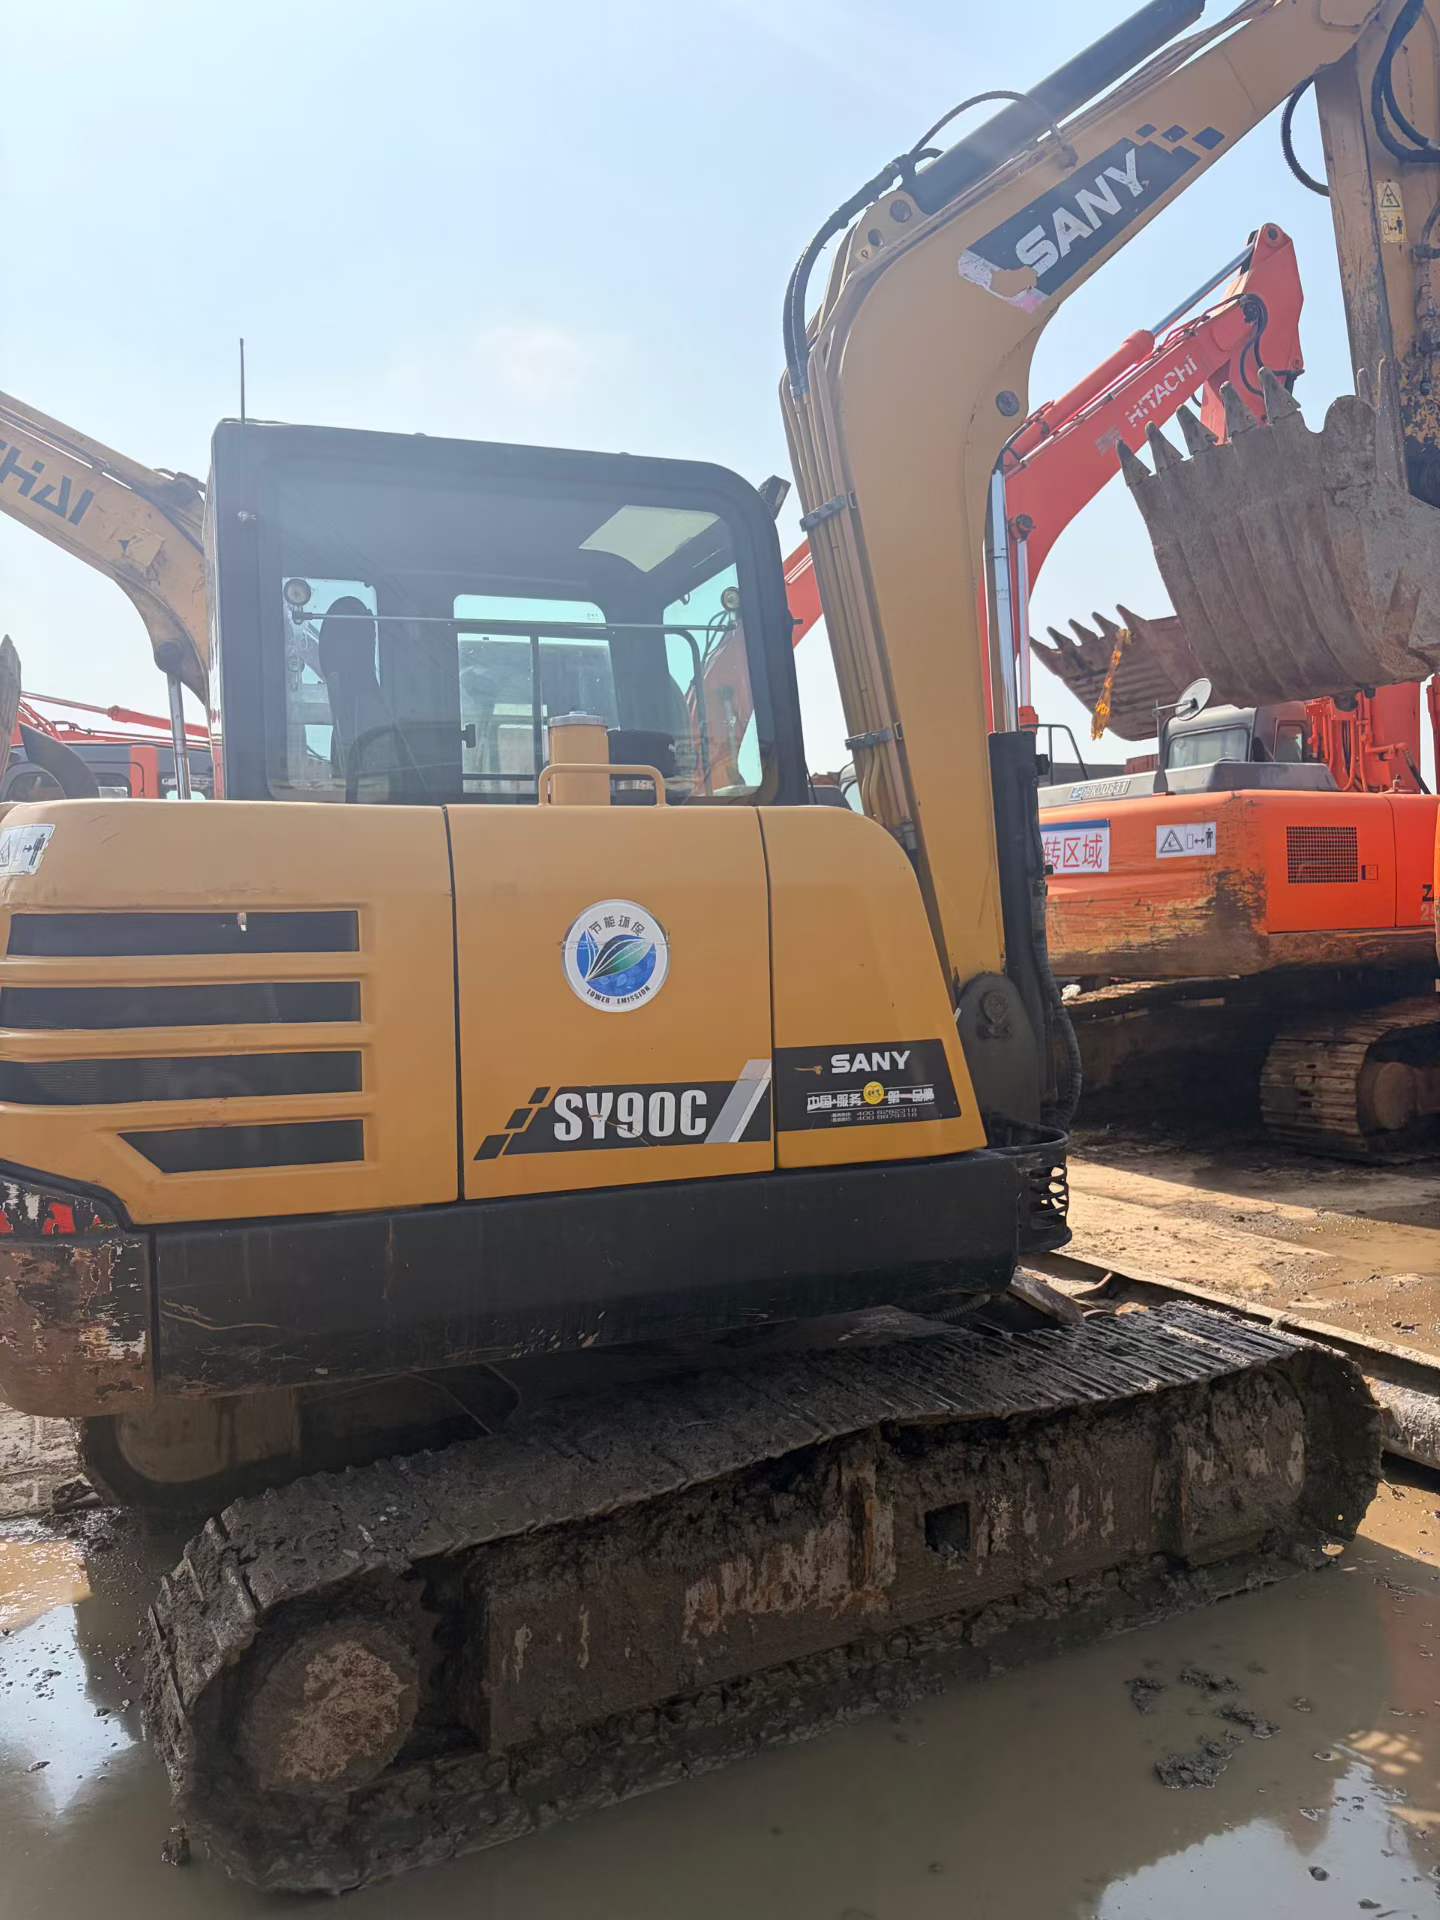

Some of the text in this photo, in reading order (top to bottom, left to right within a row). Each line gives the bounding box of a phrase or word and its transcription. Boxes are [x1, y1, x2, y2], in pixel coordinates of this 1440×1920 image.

[1016, 148, 1144, 277] SANY
[1125, 353, 1198, 428] HITACHI
[0, 441, 95, 526] HAI
[588, 915, 646, 936] 节能环保
[586, 985, 651, 1004] LOWER EMISSION
[831, 1050, 911, 1074] SANY
[553, 1089, 707, 1141] SY90C
